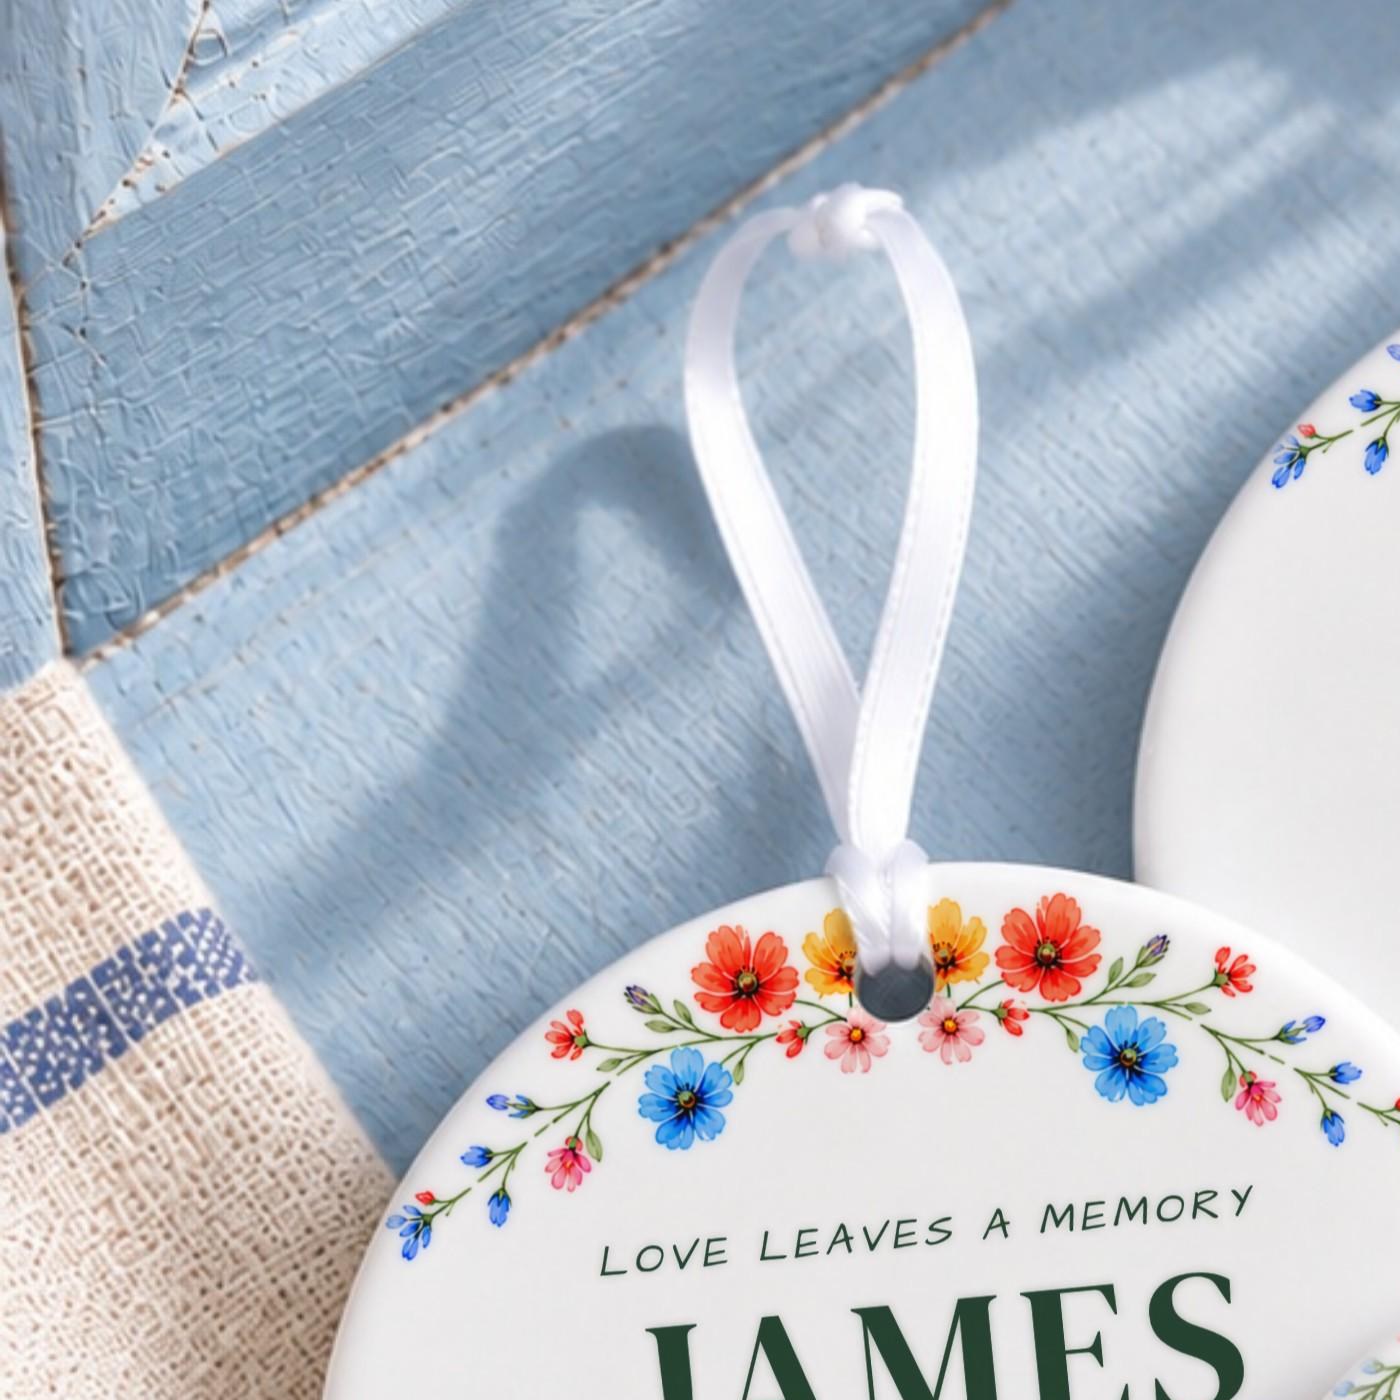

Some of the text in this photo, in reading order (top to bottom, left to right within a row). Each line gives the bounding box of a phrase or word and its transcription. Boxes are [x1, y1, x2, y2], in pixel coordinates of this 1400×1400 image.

[599, 1184, 1254, 1277] LOVE LEAVES A MEMORY
